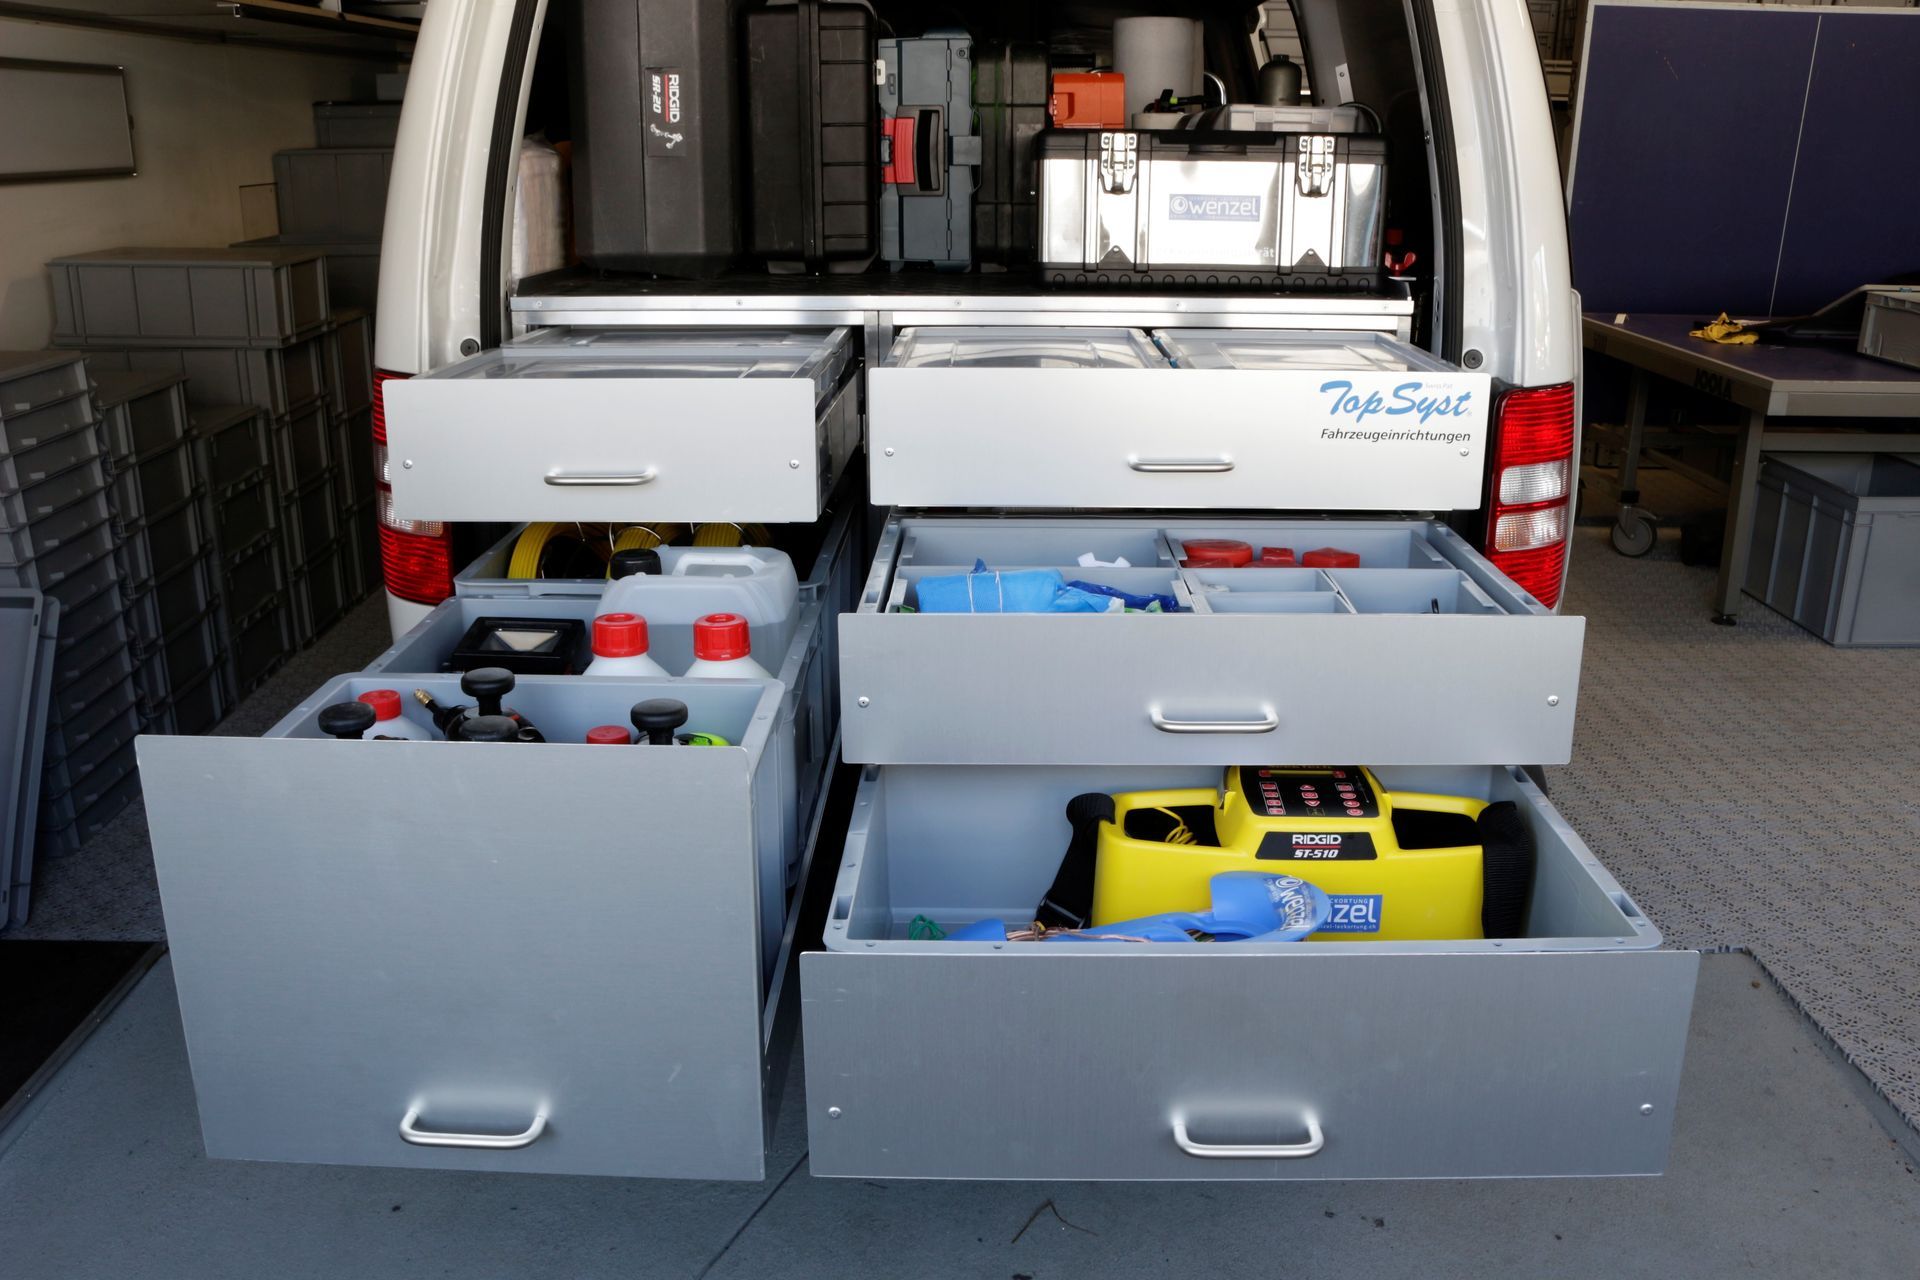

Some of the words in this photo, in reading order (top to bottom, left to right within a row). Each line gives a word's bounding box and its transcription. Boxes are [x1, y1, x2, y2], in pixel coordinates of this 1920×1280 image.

[652, 74, 661, 113] SR-20
[669, 74, 680, 123] RIDGID
[1189, 197, 1258, 216] wenzel
[1320, 428, 1471, 444] Fahrzeugeinrichtungen
[1292, 834, 1341, 845] RIDGID
[1294, 849, 1339, 858] ST-510
[1327, 898, 1377, 924] zel
